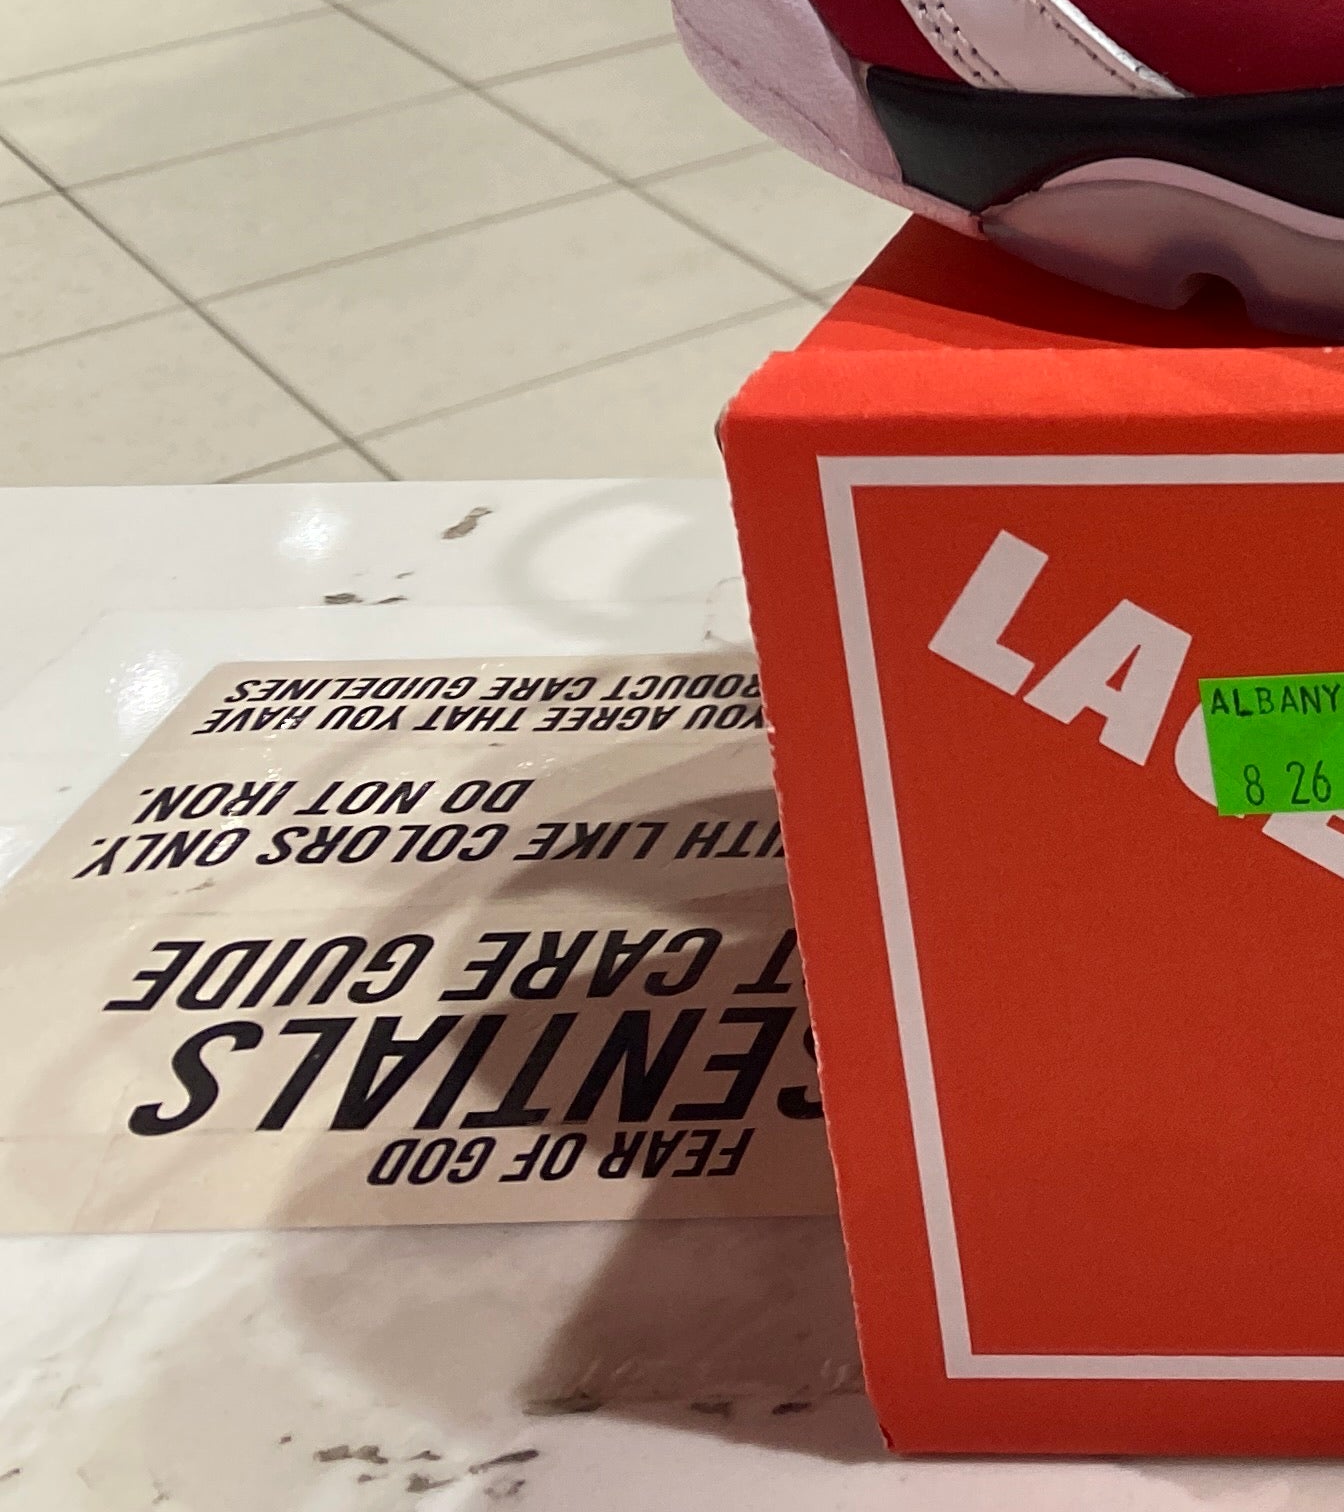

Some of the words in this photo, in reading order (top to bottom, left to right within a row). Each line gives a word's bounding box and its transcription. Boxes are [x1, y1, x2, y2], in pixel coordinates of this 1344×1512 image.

[223, 676, 478, 704] GUIDELINES
[480, 676, 597, 702] CARE
[600, 673, 761, 702] RODUCT
[1210, 683, 1341, 717] ALBANY
[191, 705, 318, 736] HAVE
[315, 705, 409, 732] YOU
[412, 705, 528, 732] THAT
[532, 705, 681, 732] AGREE
[682, 703, 766, 730] YOU
[294, 780, 436, 816] NOT
[440, 779, 535, 814] DO
[1243, 763, 1266, 806] 8
[1286, 759, 1332, 805] 26
[131, 780, 299, 825] IRON.
[71, 827, 250, 880] ONLY.
[255, 823, 510, 865] COLORS
[512, 821, 669, 861] LIKE
[673, 820, 787, 859] ITH
[101, 933, 436, 1012] GUIDE
[439, 928, 723, 1003] CARE
[366, 1134, 506, 1186] GOD
[499, 1130, 583, 1184] OF
[597, 1128, 754, 1180] FEAR
